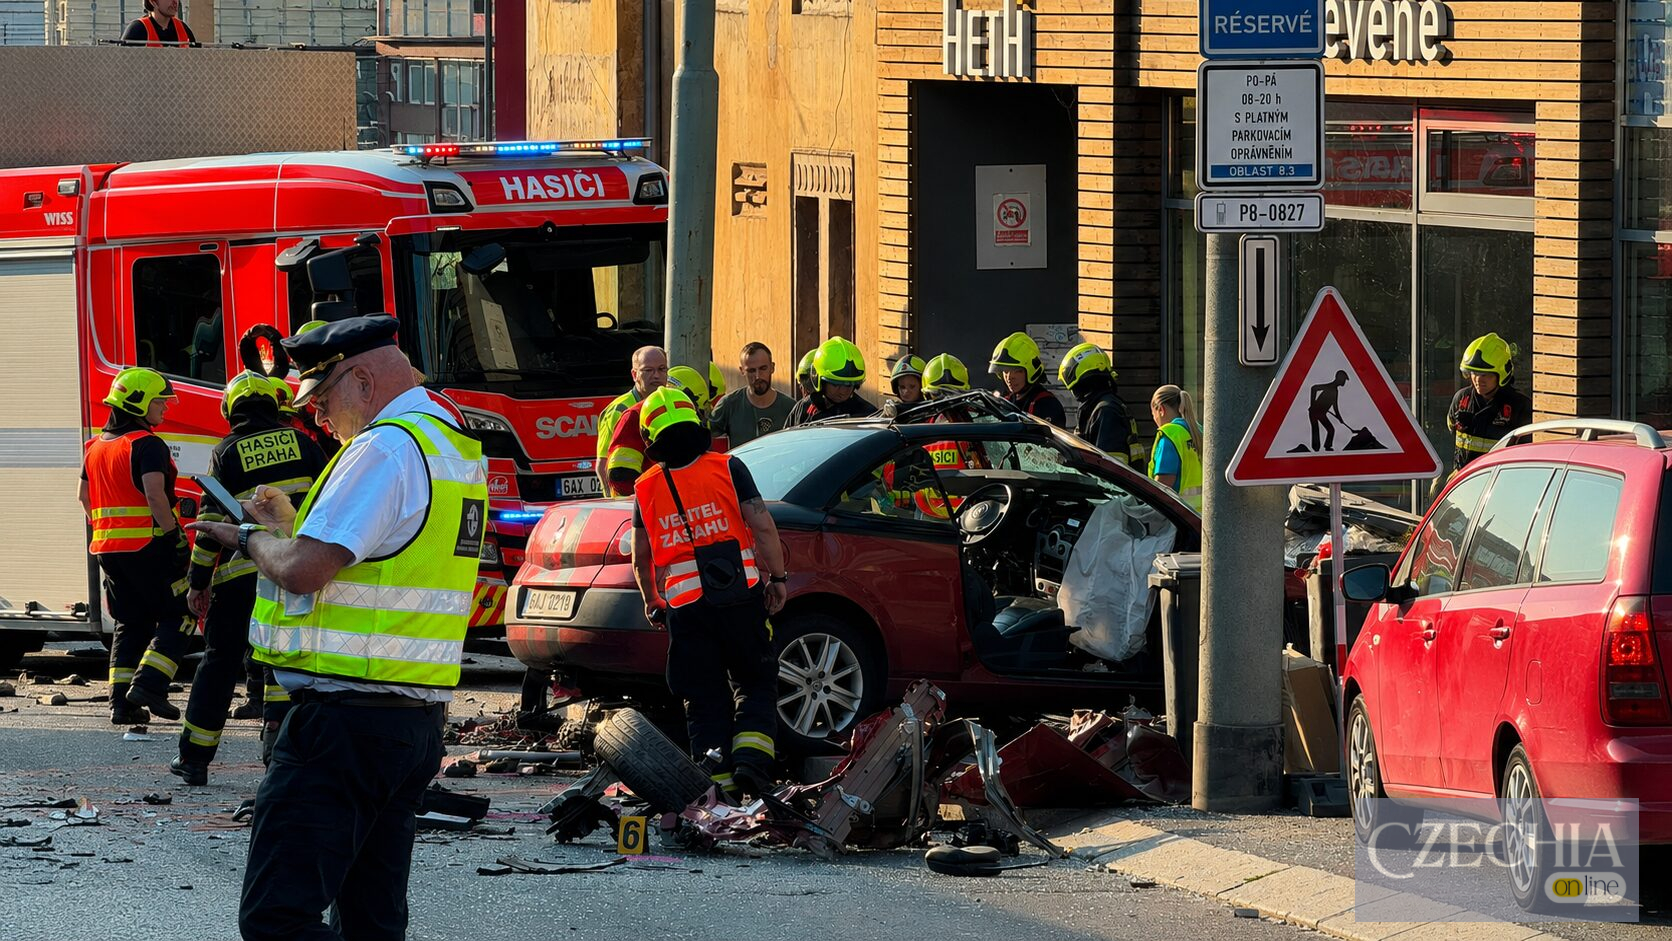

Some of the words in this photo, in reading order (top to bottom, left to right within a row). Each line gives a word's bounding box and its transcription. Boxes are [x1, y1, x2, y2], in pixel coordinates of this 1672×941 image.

[1214, 10, 1312, 34] RÉSERVÉ
[1246, 72, 1277, 87] PO-PÁ
[1241, 93, 1272, 105] 08-20
[1275, 93, 1282, 105] h
[1234, 112, 1241, 124] S
[1245, 108, 1289, 124] PLATNÝM
[1231, 127, 1292, 142] PARKOVACÍM
[1230, 144, 1293, 160] OPRÁVNĚNÍM
[1229, 166, 1273, 177] OBLAST
[1278, 166, 1295, 176] 8.3
[499, 169, 605, 201] HASIČI
[44, 211, 74, 226] WISS
[1239, 203, 1305, 222] P8-0827
[239, 430, 296, 454] HASIČI
[244, 446, 298, 469] PRAHA
[563, 479, 584, 494] 6AX
[622, 820, 641, 849] 6
